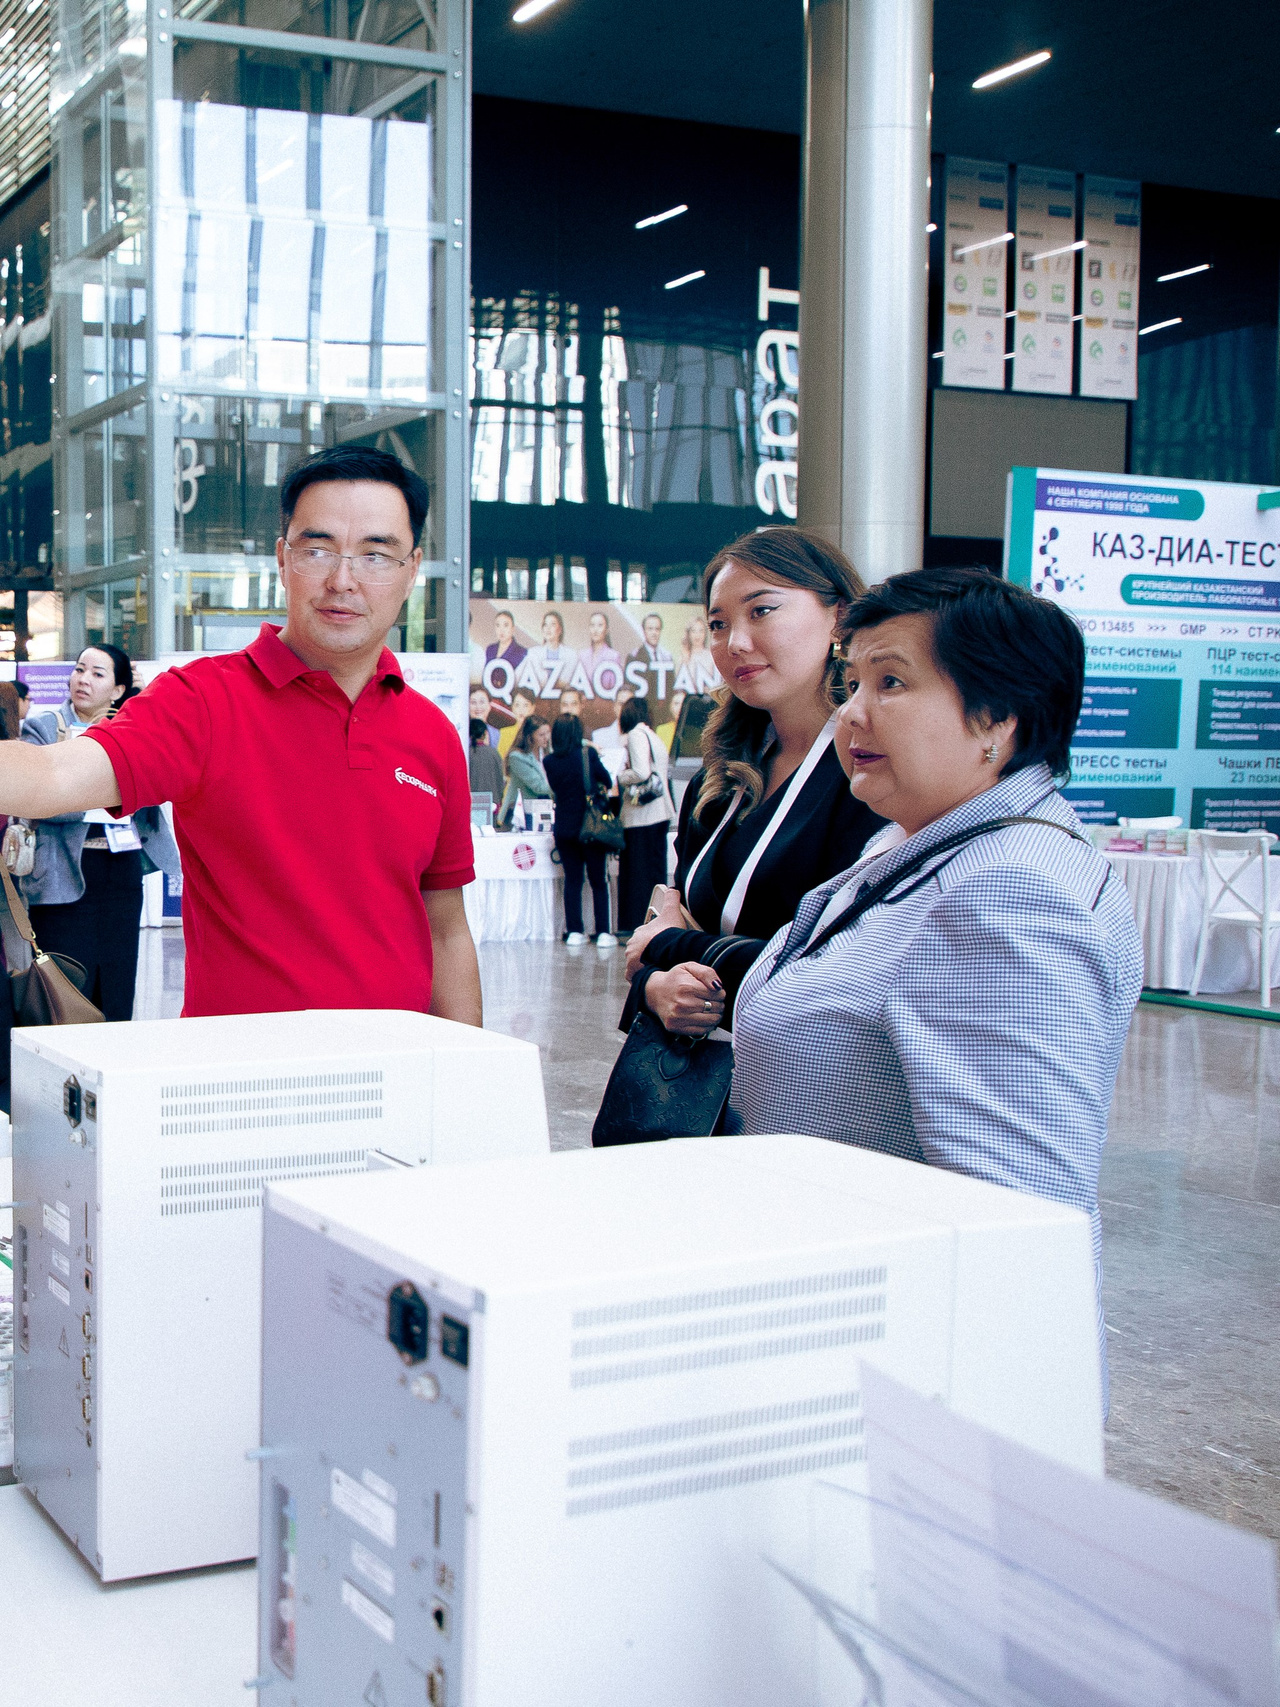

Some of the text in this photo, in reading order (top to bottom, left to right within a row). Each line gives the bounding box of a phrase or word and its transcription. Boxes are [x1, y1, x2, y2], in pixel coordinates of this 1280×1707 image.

[1092, 531, 1280, 567] КАЗ-ДИА-ТЕС
[1180, 623, 1207, 635] GMP
[483, 657, 721, 706] QAZAQSTAN
[1125, 758, 1167, 769] тесты
[1218, 755, 1261, 769] Чашки
[1248, 773, 1280, 784] пози
